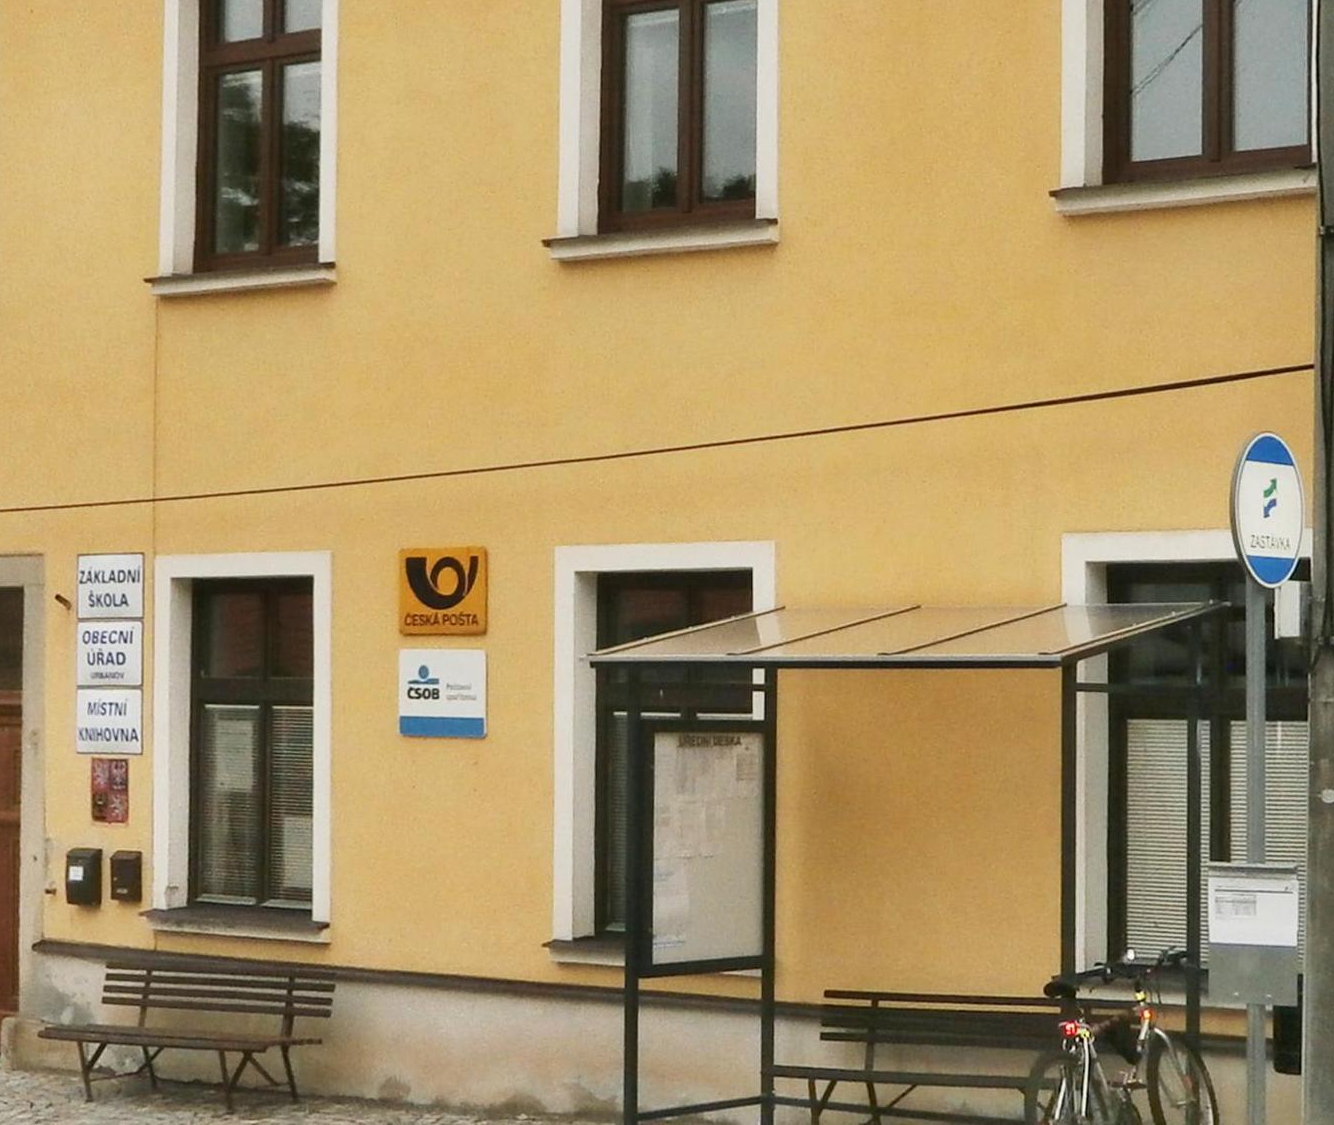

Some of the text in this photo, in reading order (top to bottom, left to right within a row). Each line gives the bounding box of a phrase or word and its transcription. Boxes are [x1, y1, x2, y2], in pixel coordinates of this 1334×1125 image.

[79, 565, 141, 584] ZÁKLADNÍ
[88, 590, 129, 607] ŠKOLA
[404, 611, 479, 626] ČESKÁ POŠTA
[82, 626, 135, 644] OBECNÍ
[87, 648, 126, 666] ÚŘAD
[407, 686, 440, 700] ČSOB
[87, 698, 128, 716] MÍSTNÍ
[78, 727, 139, 742] KNIHOVNA
